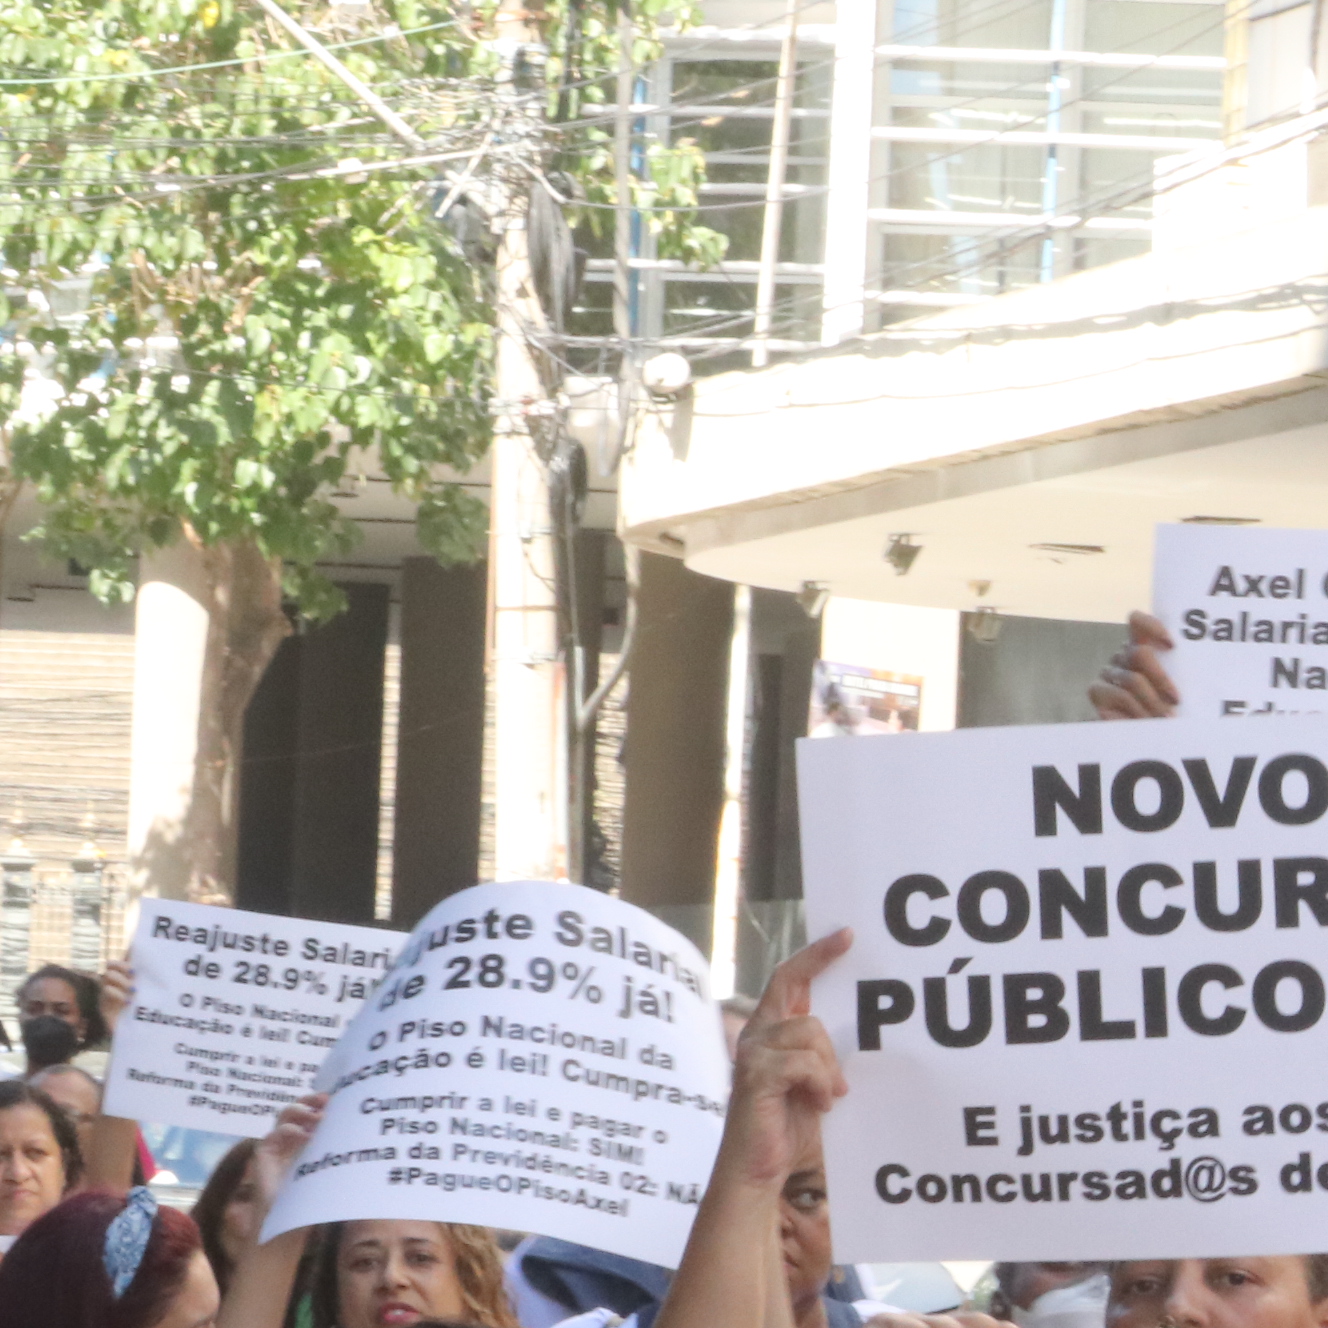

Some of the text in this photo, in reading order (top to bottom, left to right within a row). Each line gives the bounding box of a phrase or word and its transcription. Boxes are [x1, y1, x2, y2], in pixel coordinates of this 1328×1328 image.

[1208, 566, 1305, 600] Axel
[153, 916, 289, 953] Reajuste
[184, 954, 221, 979] de
[232, 960, 329, 995] 28.9%
[378, 953, 676, 1024] de 28.9% já!
[134, 1006, 233, 1036] Educação
[201, 995, 244, 1016] Piso
[252, 1003, 339, 1028] Nacional
[855, 957, 1327, 1052] PÚBLICO
[399, 1018, 467, 1043] Piso
[480, 1014, 628, 1060] Nacional
[639, 1043, 676, 1071] da
[467, 1046, 486, 1069] é
[499, 1047, 550, 1077] lei!
[360, 1092, 670, 1145] Cumprir a lei e pagar o
[379, 1118, 645, 1168] Piso Nacional: SIM!
[963, 1106, 999, 1147] E
[1016, 1098, 1220, 1155] justiça
[293, 1141, 659, 1197] Reforma da Previdência 02:
[387, 1167, 630, 1219] #PagueOPisoAxel
[873, 1154, 1259, 1205] Concursad@s
